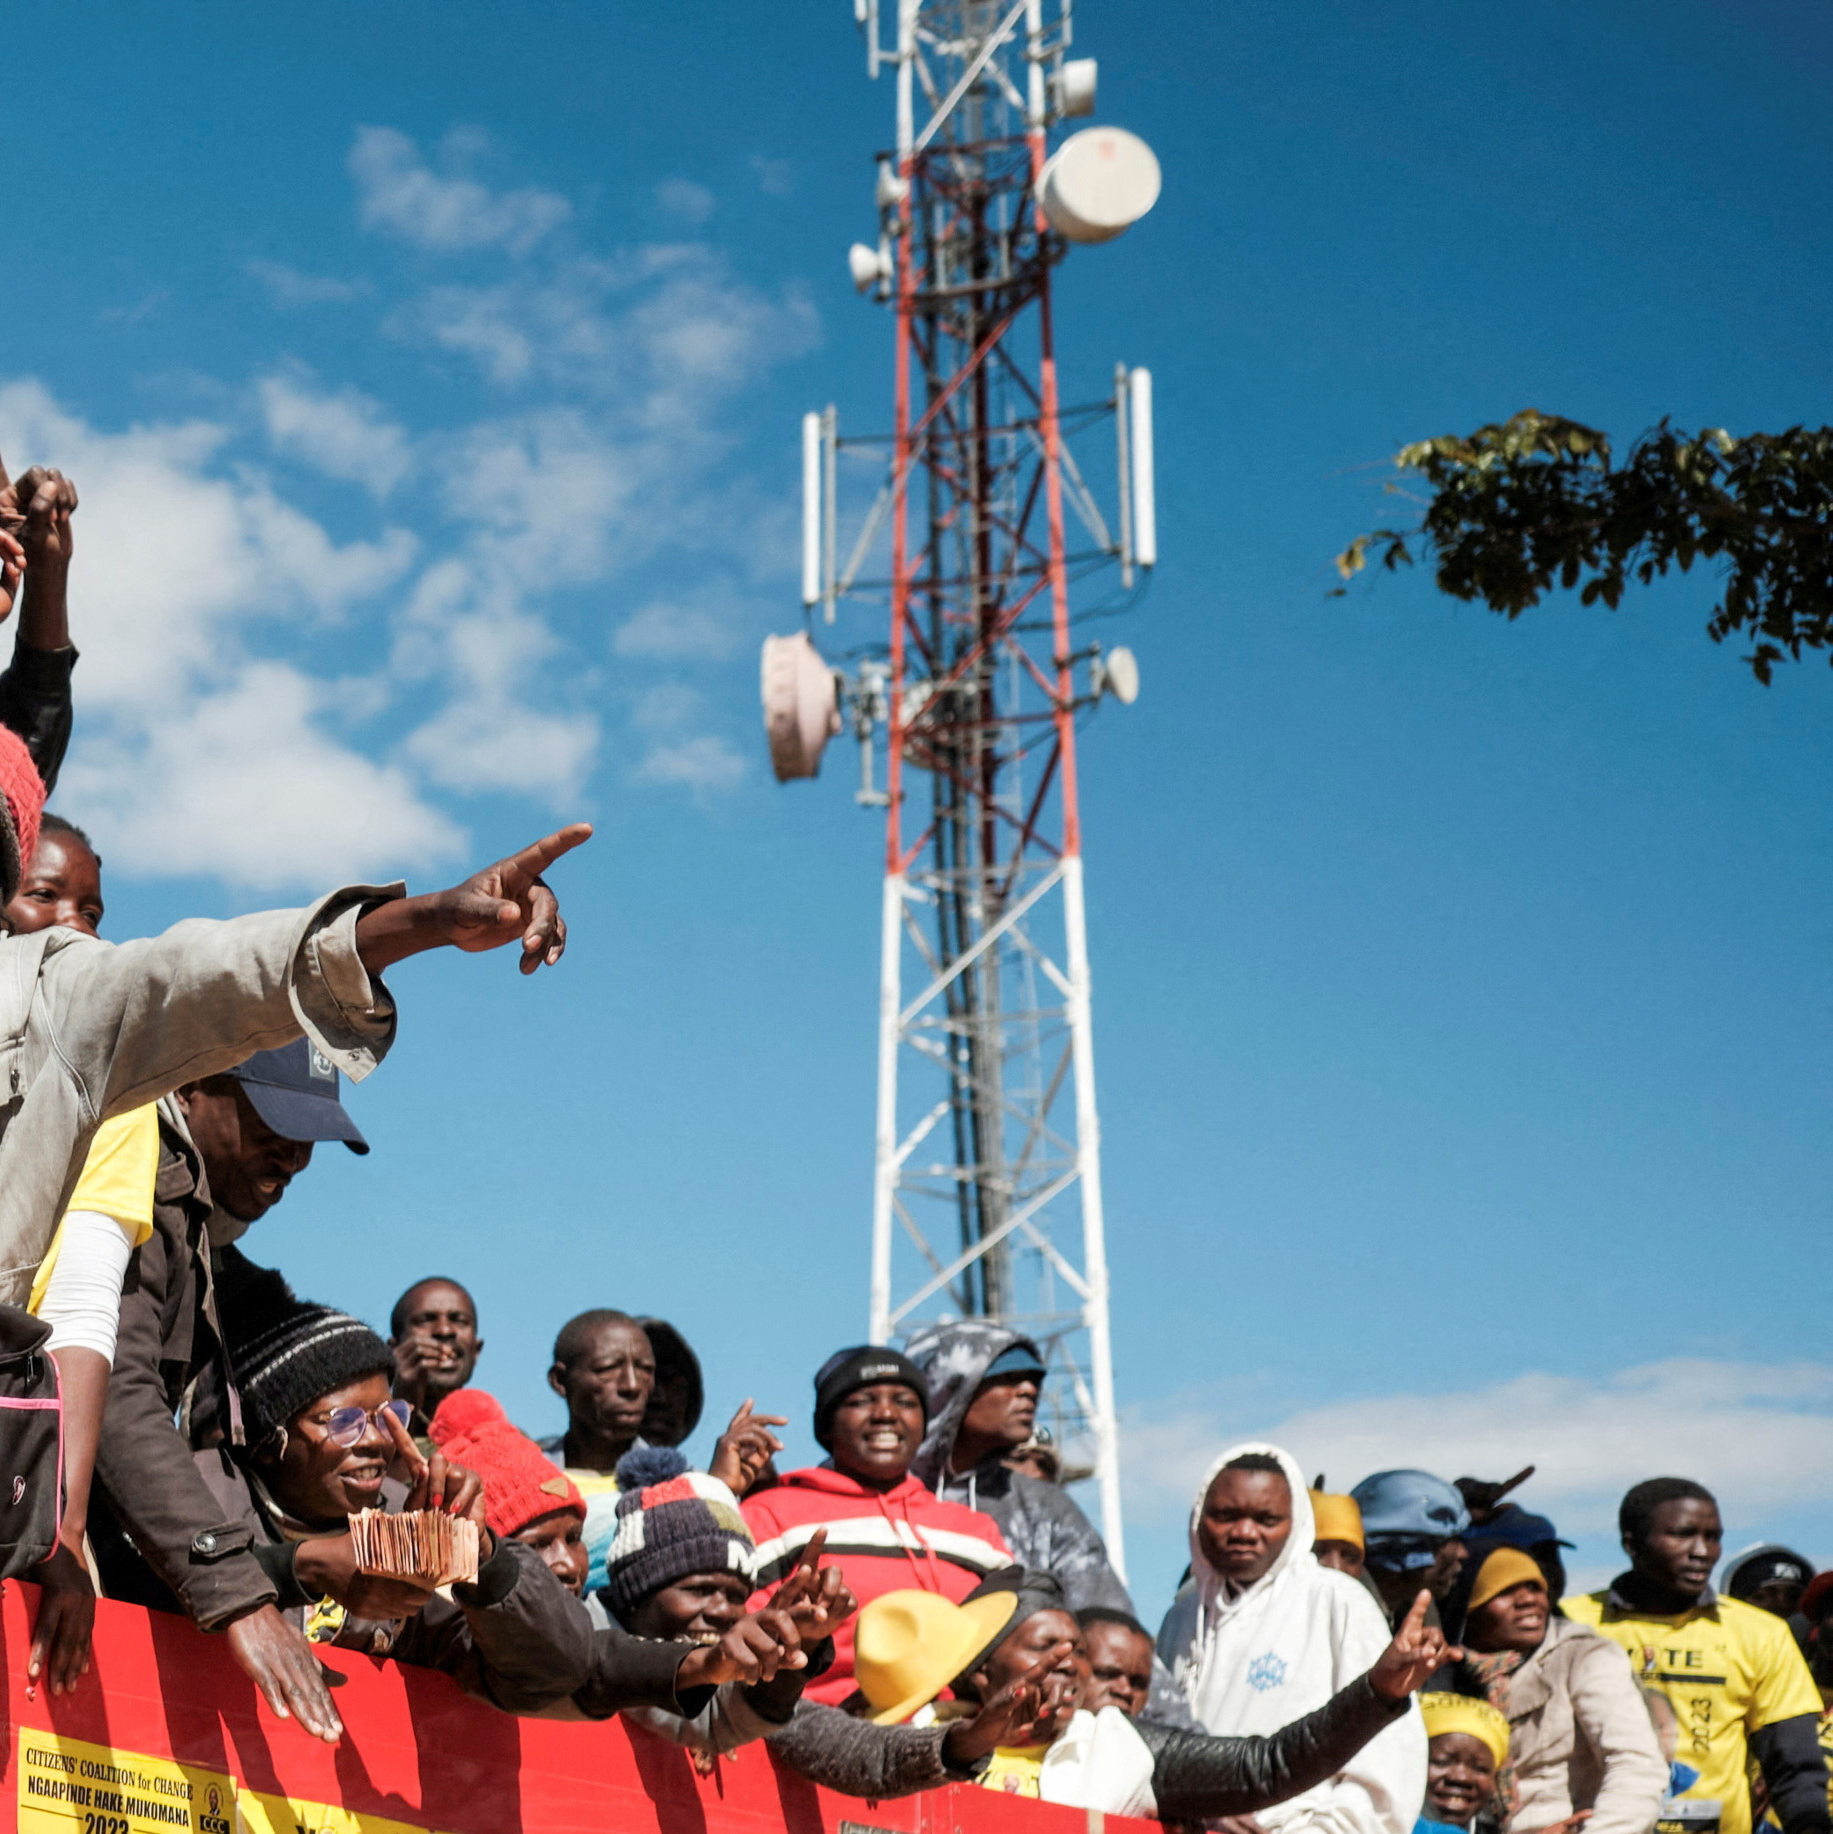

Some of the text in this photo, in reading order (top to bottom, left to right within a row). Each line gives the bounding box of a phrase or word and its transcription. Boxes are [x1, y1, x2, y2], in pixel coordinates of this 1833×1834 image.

[80, 1760, 135, 1787] COALITION
[139, 1774, 150, 1791] for
[154, 1777, 193, 1800] CHANGE
[28, 1776, 189, 1827] NGAAPINDE HAKE MUKOMANA
[203, 1817, 225, 1834] CCC
